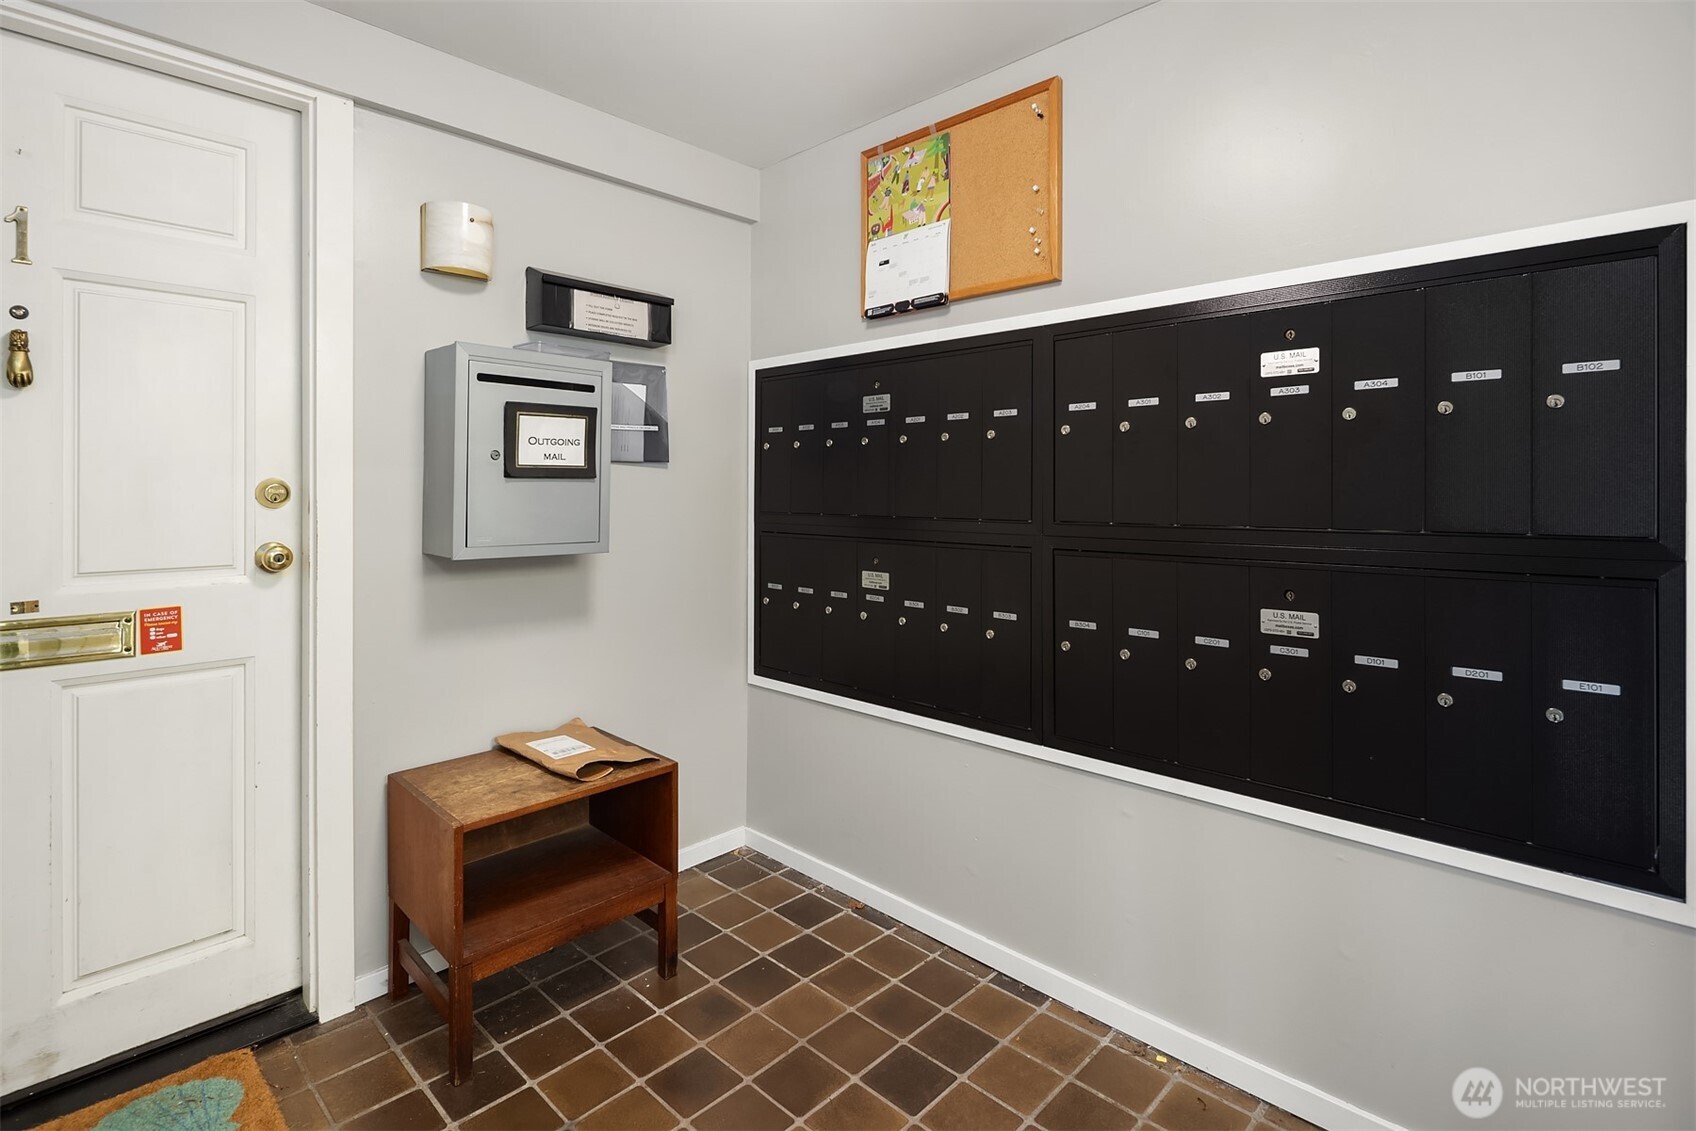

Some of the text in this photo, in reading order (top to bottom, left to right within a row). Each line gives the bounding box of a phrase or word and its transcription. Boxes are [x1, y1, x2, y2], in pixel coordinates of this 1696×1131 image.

[4, 205, 32, 265] 1
[1576, 362, 1604, 371] B102
[1363, 380, 1388, 388] A304
[528, 436, 581, 446] OUTGOING
[543, 453, 566, 461] MAIL
[1288, 613, 1306, 621] MAIL
[1279, 647, 1299, 655] C301
[1366, 657, 1385, 665] D101
[1465, 670, 1489, 678] D201
[1579, 683, 1603, 691] E101
